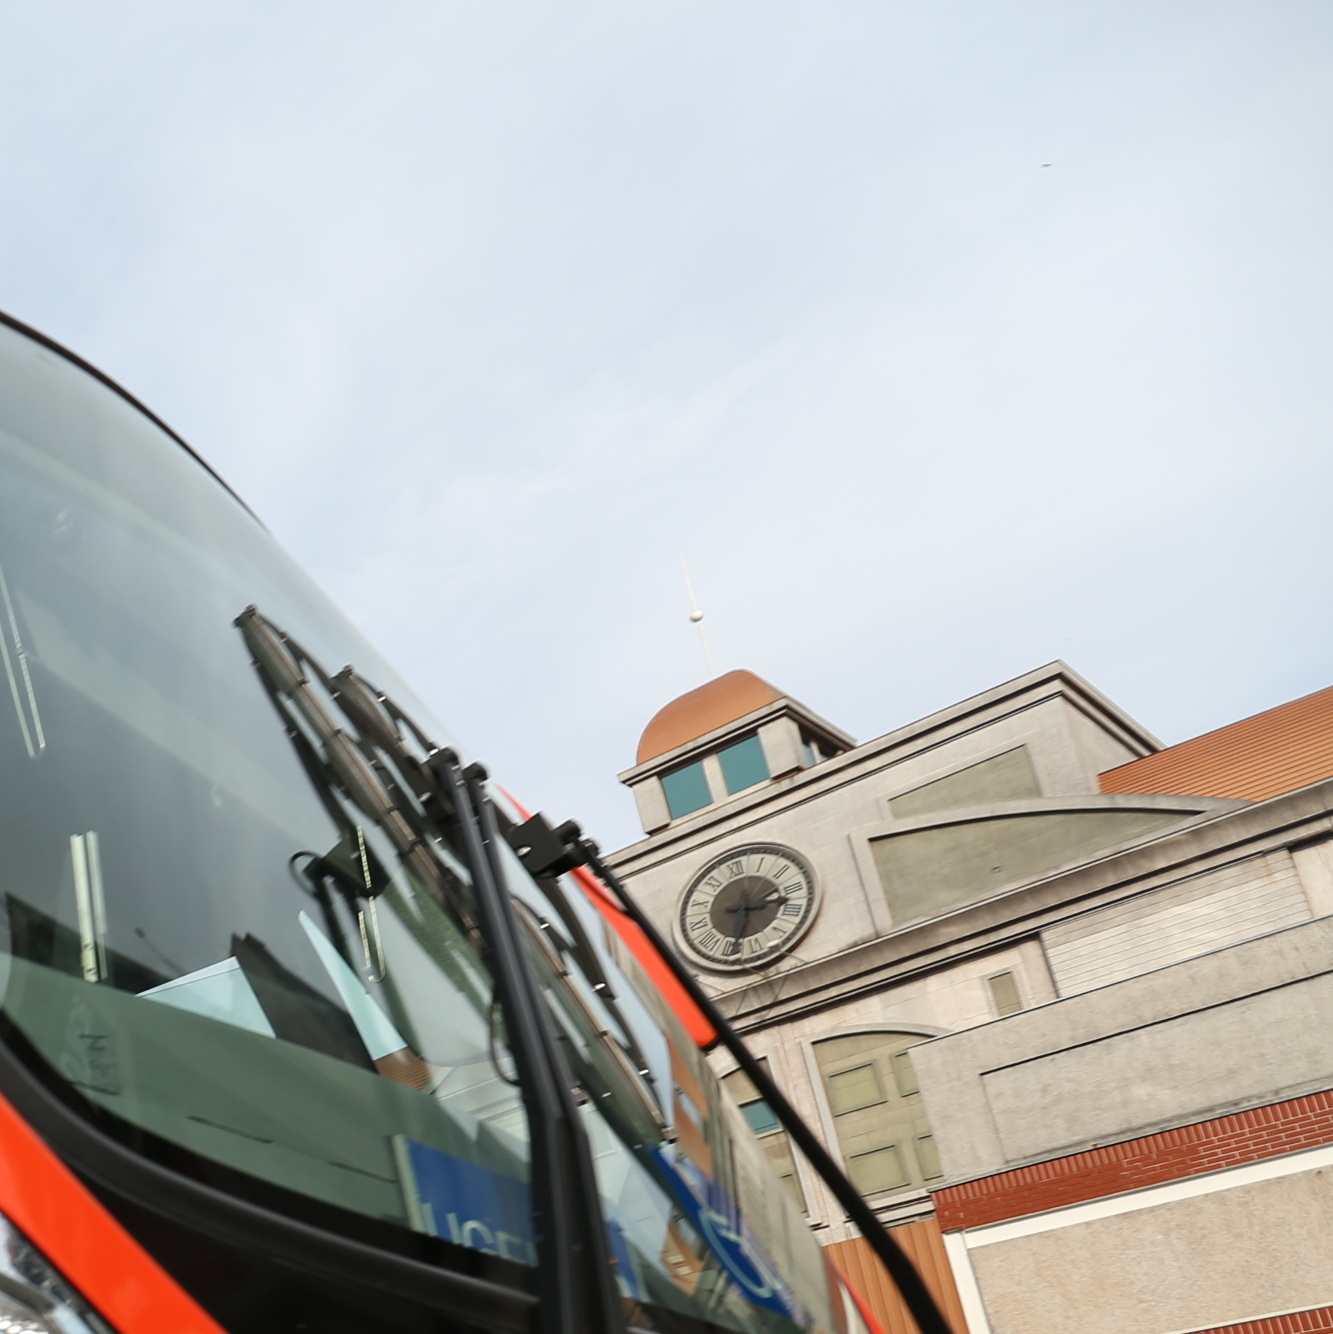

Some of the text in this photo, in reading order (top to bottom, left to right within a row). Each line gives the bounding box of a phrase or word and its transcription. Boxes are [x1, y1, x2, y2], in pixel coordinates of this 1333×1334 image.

[727, 859, 745, 879] XII
[756, 857, 766, 873] I
[773, 864, 791, 879] II
[704, 875, 723, 892] XI
[784, 881, 804, 895] III
